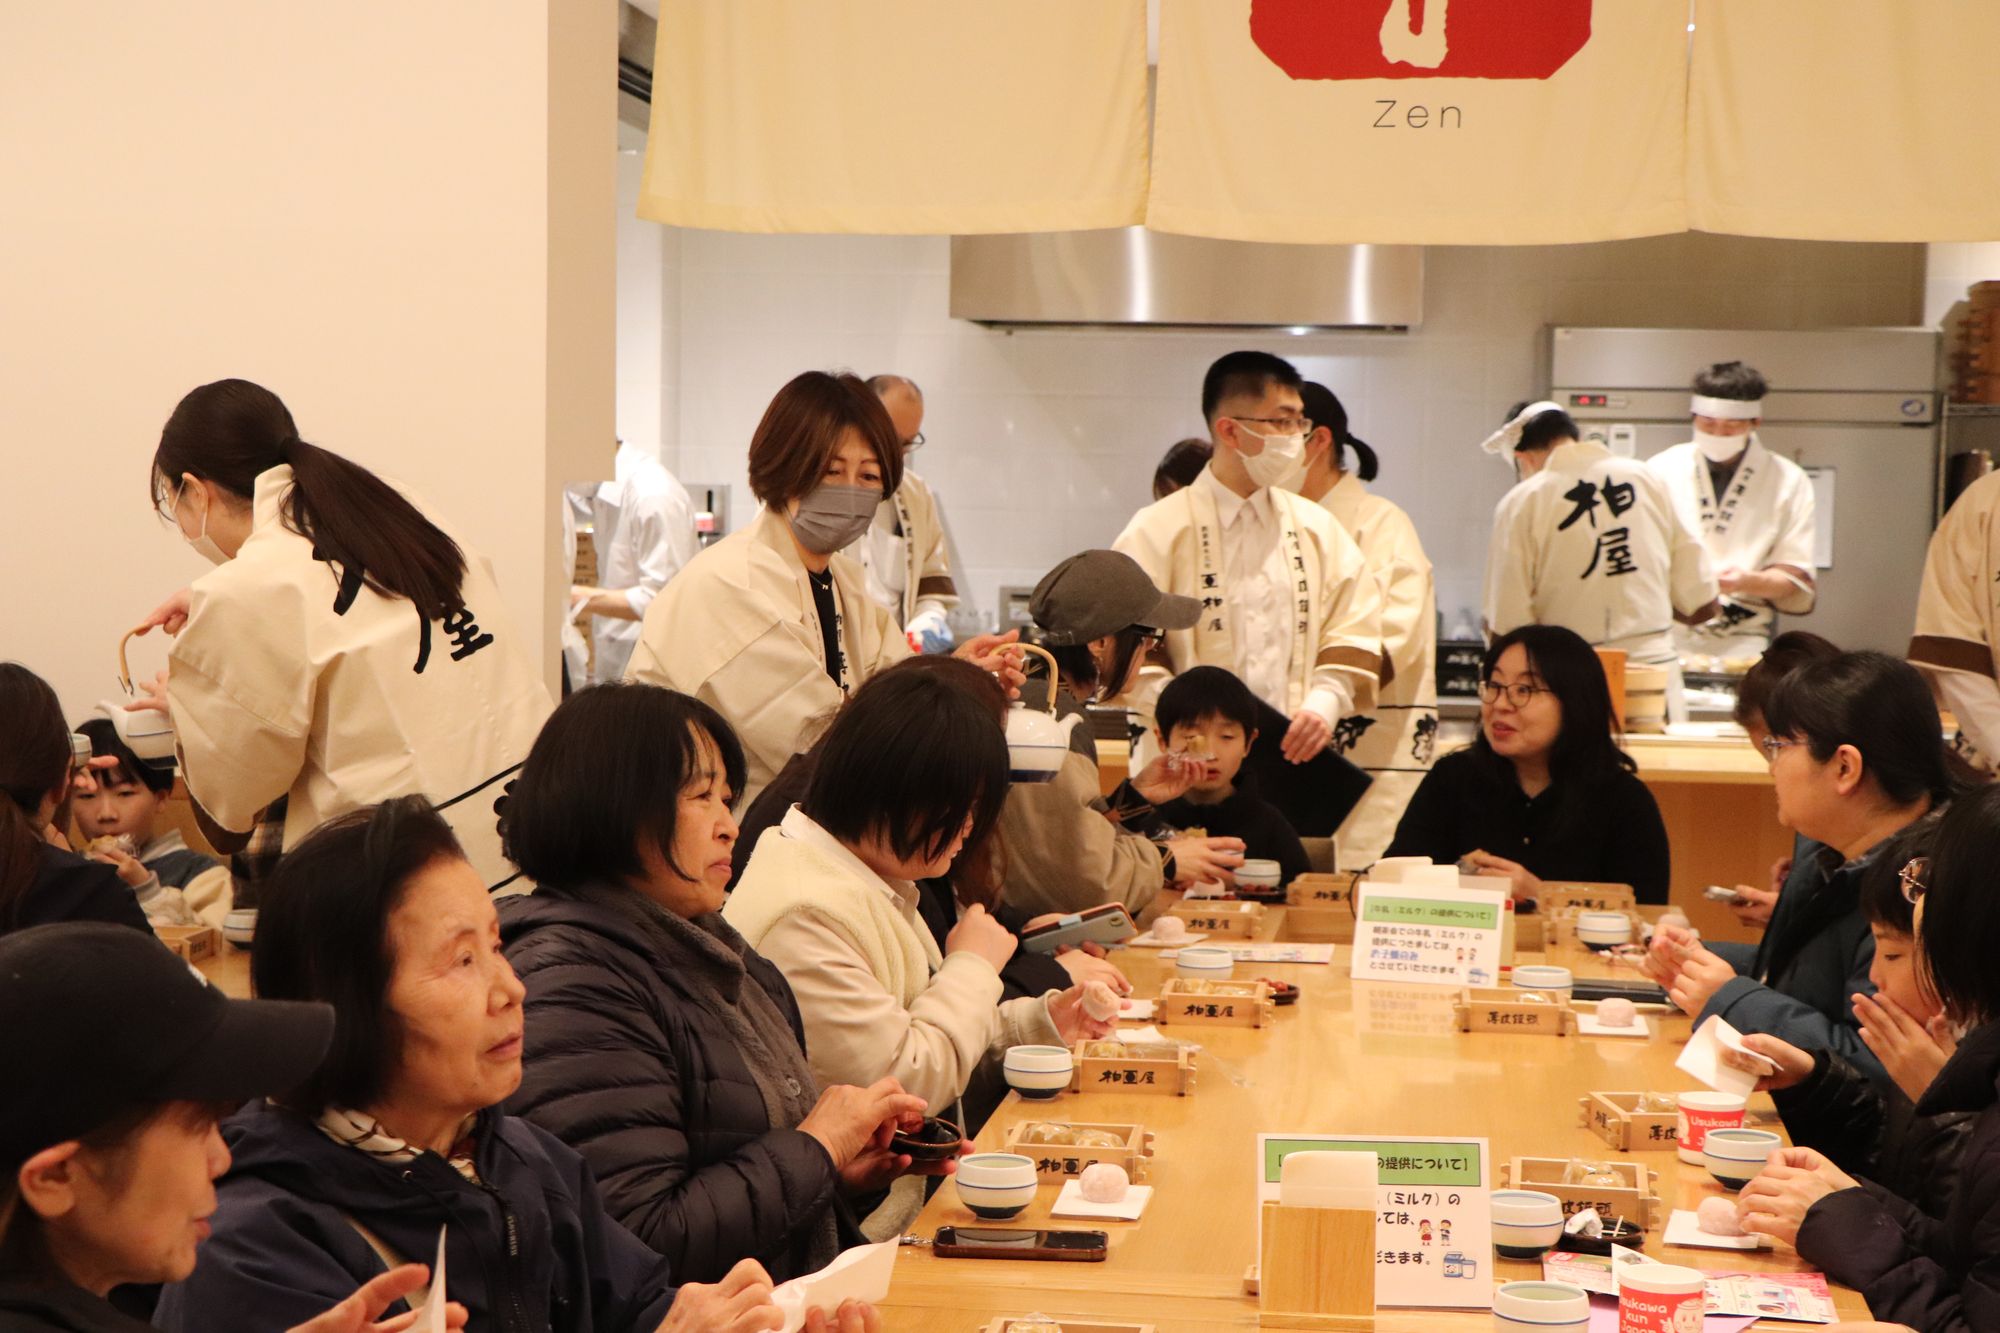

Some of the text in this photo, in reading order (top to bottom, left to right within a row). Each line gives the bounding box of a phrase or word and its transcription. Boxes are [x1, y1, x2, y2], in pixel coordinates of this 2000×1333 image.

[1373, 100, 1461, 128] Zen
[1557, 474, 1638, 580] 柏屋
[1691, 1116, 1739, 1127] Usukawa
[1626, 1309, 1648, 1325] kun
